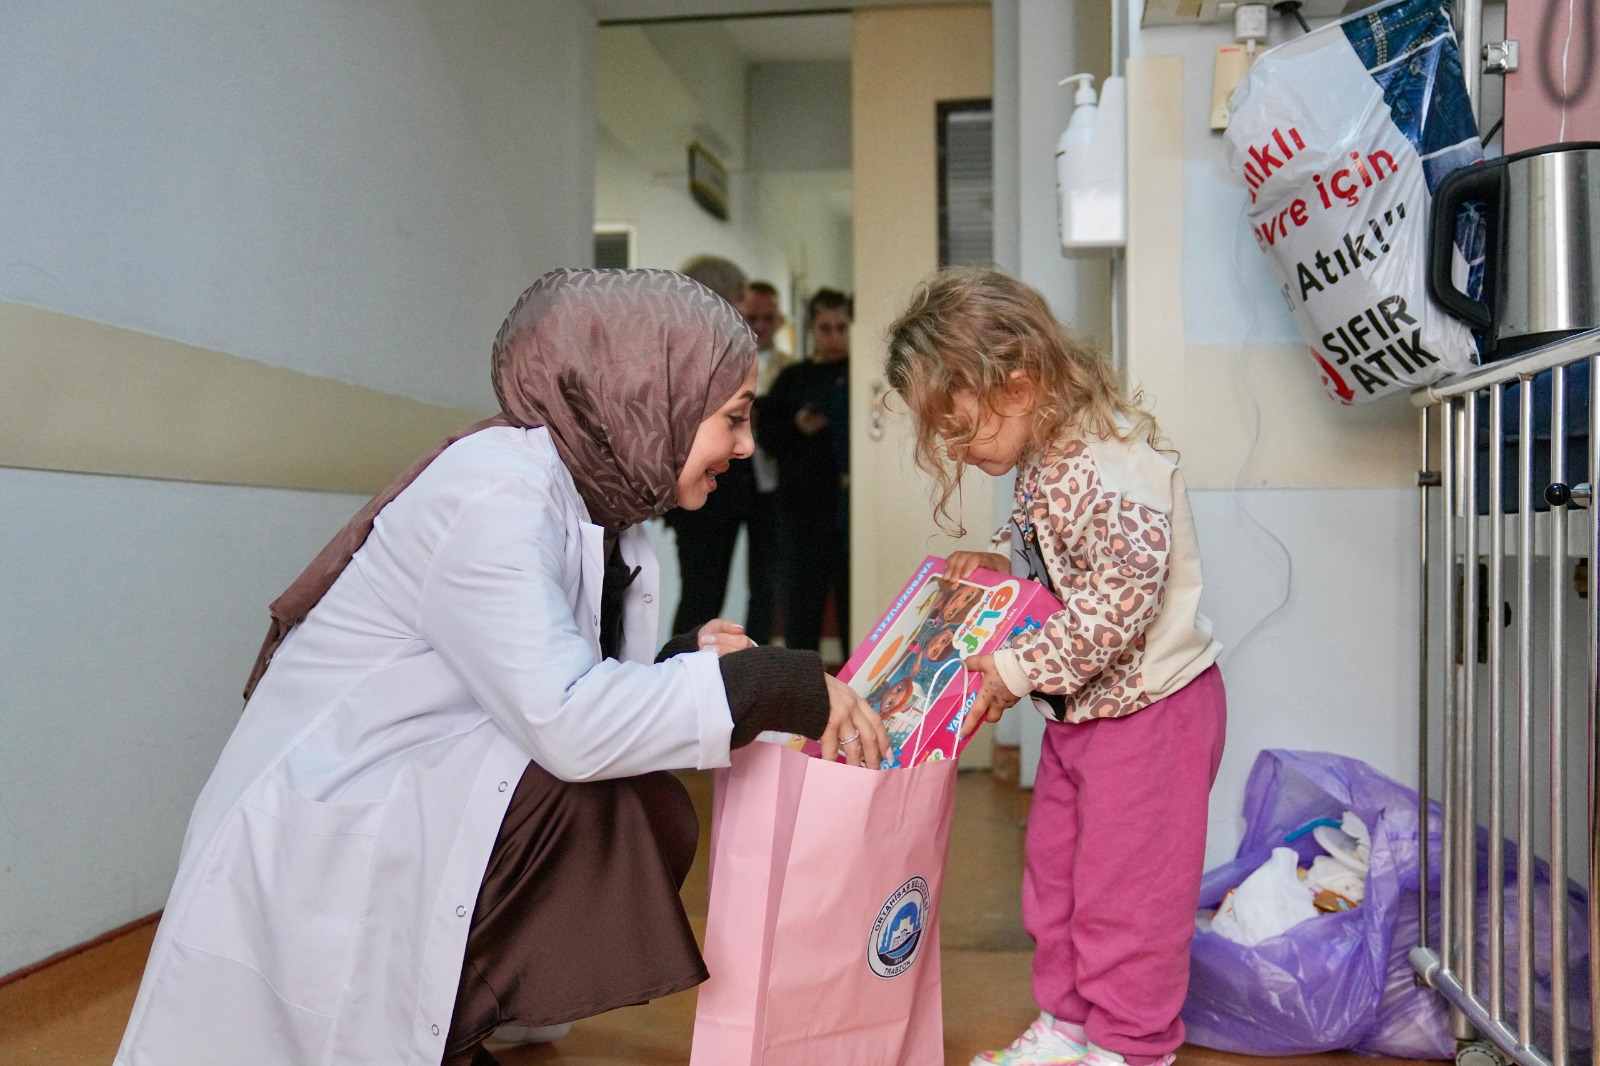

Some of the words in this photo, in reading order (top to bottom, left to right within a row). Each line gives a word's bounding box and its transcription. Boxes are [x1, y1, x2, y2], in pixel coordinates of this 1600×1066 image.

[1312, 150, 1399, 209] için
[1322, 294, 1418, 366] SIFIR
[1350, 327, 1441, 395] ATIK
[883, 959, 911, 975] TRABZON
